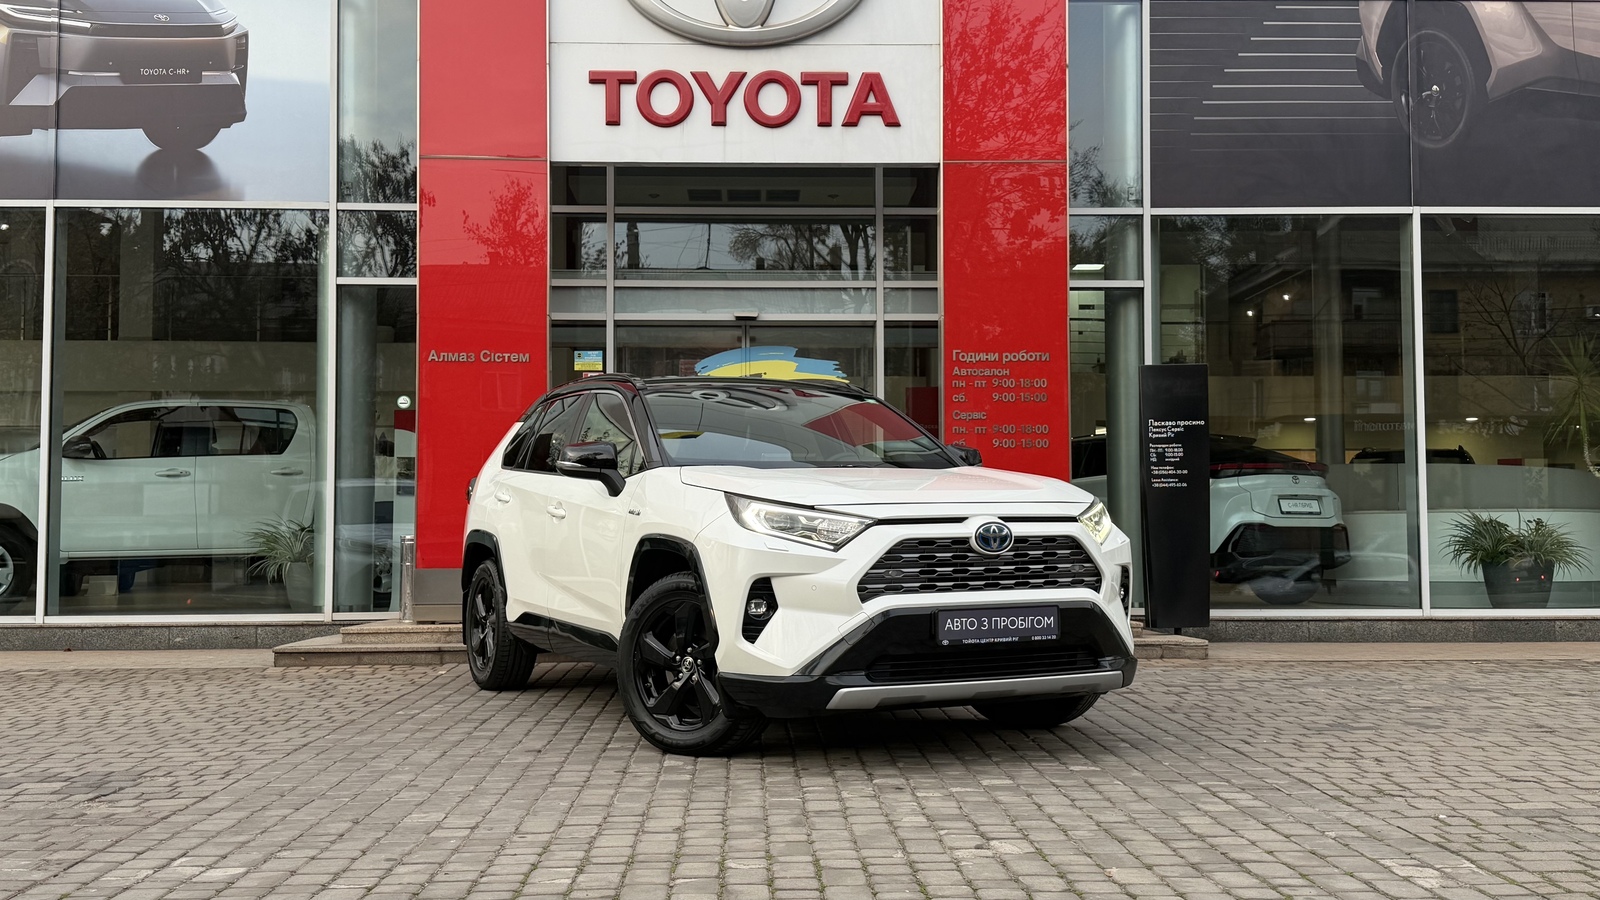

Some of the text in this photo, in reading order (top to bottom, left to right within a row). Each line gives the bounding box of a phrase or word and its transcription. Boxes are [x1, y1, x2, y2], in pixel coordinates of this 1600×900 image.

[140, 68, 190, 76] TOYOTA C-HR+
[589, 69, 901, 128] TOYOTA
[428, 349, 530, 363] Алмаз Сістем
[952, 349, 1050, 364] Години роботи
[952, 366, 1010, 376] Автосалон
[952, 410, 987, 421] Сервіс
[944, 618, 978, 631] АВТО
[991, 616, 1054, 629] ПРОБІГОМ
